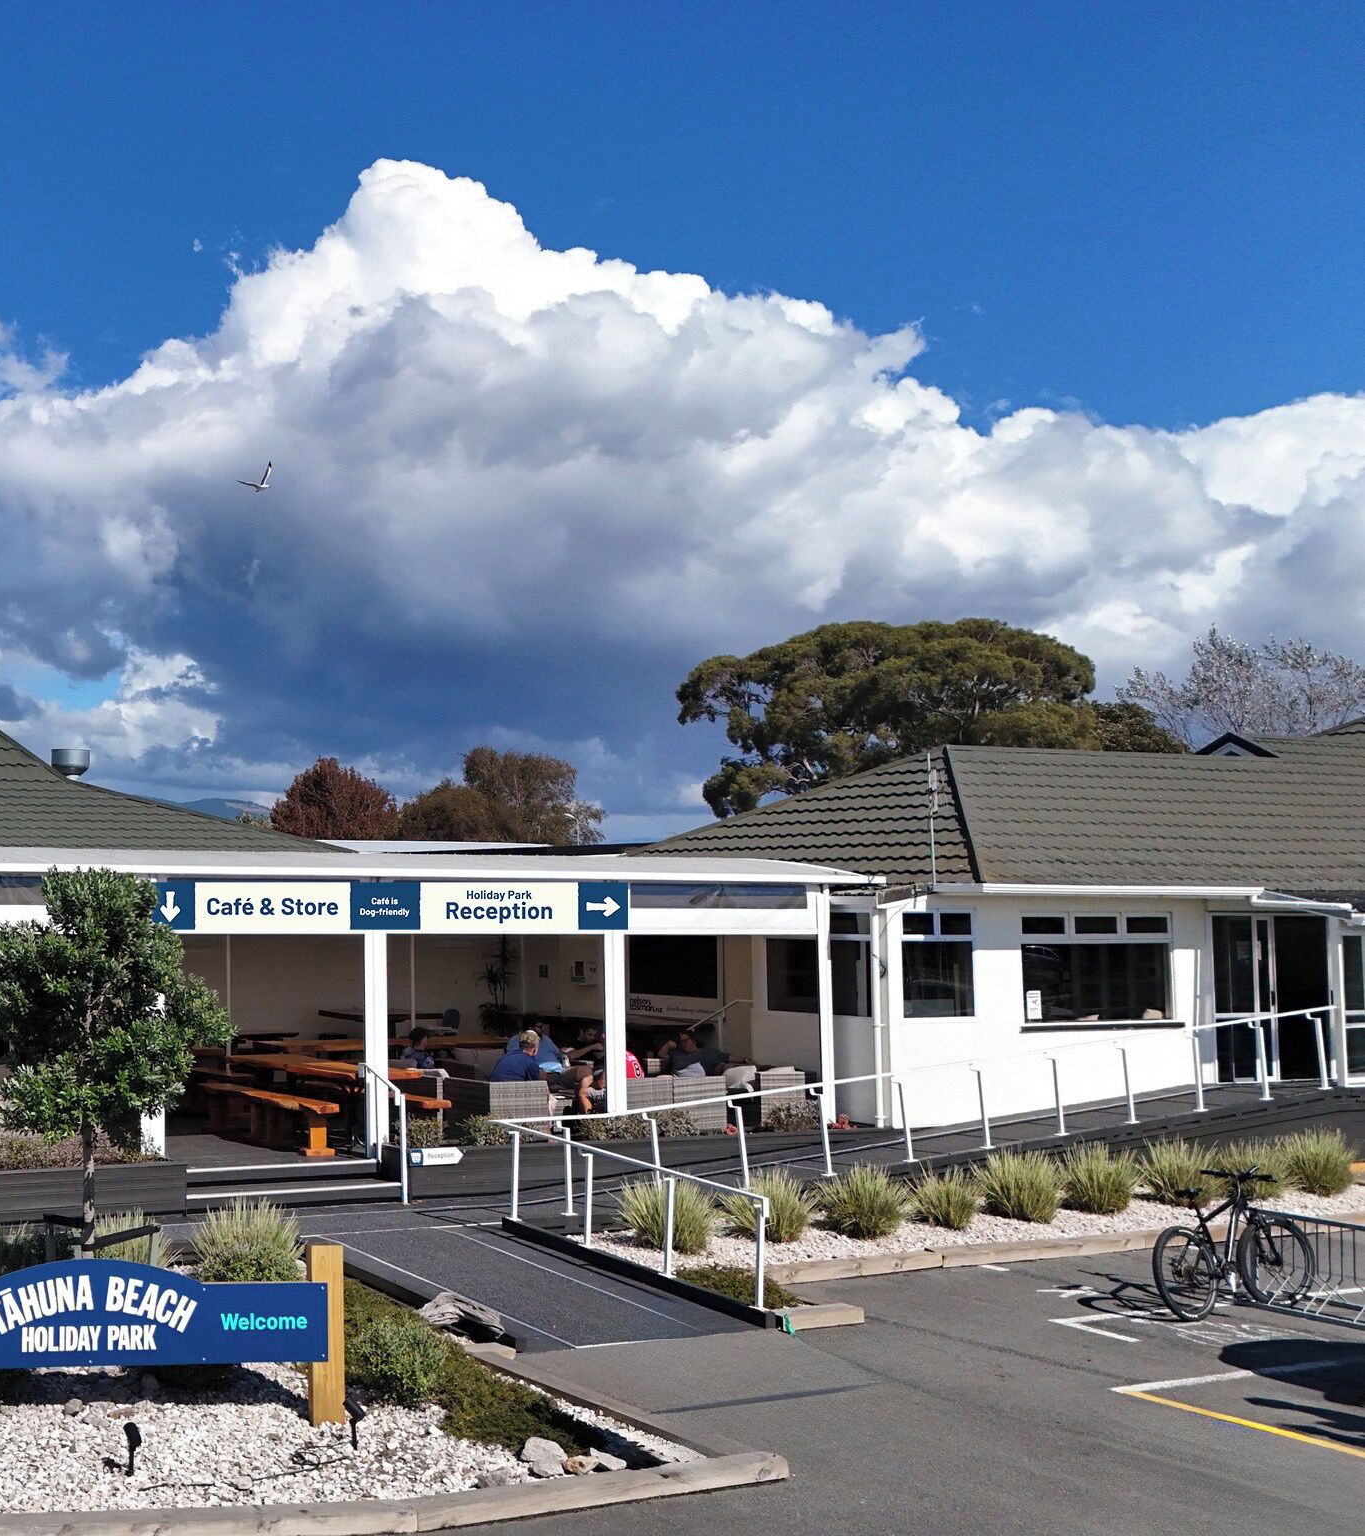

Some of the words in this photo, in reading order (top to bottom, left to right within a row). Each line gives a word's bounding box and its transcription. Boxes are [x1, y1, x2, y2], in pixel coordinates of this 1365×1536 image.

[371, 897, 390, 906] Café
[391, 897, 399, 906] is
[466, 890, 505, 902] Holiday
[507, 890, 532, 900] Park
[207, 897, 254, 916] Café
[260, 897, 275, 916] &
[281, 897, 339, 916] Store
[359, 907, 410, 918] Dog-friendly
[446, 901, 553, 924] Reception
[427, 1152, 455, 1160] Reception
[105, 1276, 198, 1333] BEACH
[220, 1312, 308, 1331] Welcome
[21, 1325, 101, 1353] HOLIDAY
[107, 1324, 157, 1351] PARK
